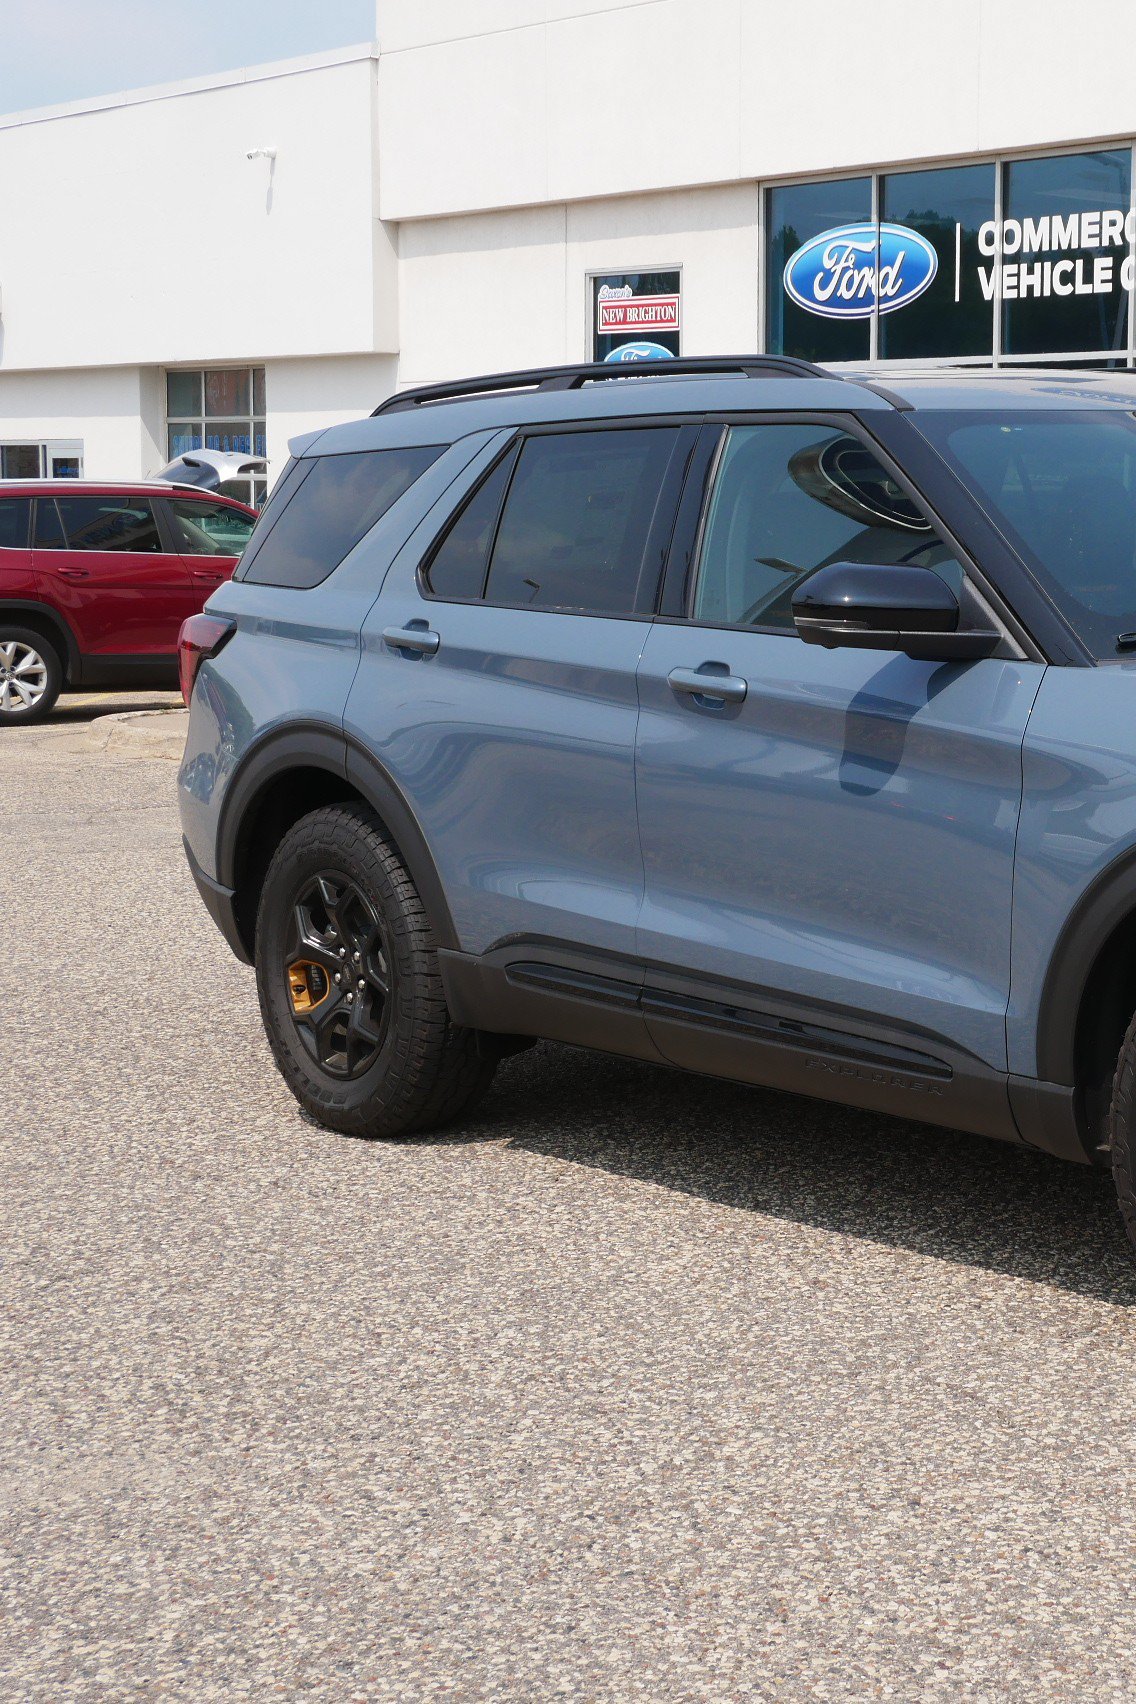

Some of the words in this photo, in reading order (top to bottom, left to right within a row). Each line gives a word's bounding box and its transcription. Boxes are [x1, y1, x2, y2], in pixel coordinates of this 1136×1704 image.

[813, 239, 906, 302] Ford
[977, 257, 1113, 301] VEHICLE
[602, 307, 625, 323] NEW
[626, 304, 676, 322] BRIGHTON
[805, 1057, 944, 1096] EXPLORER
